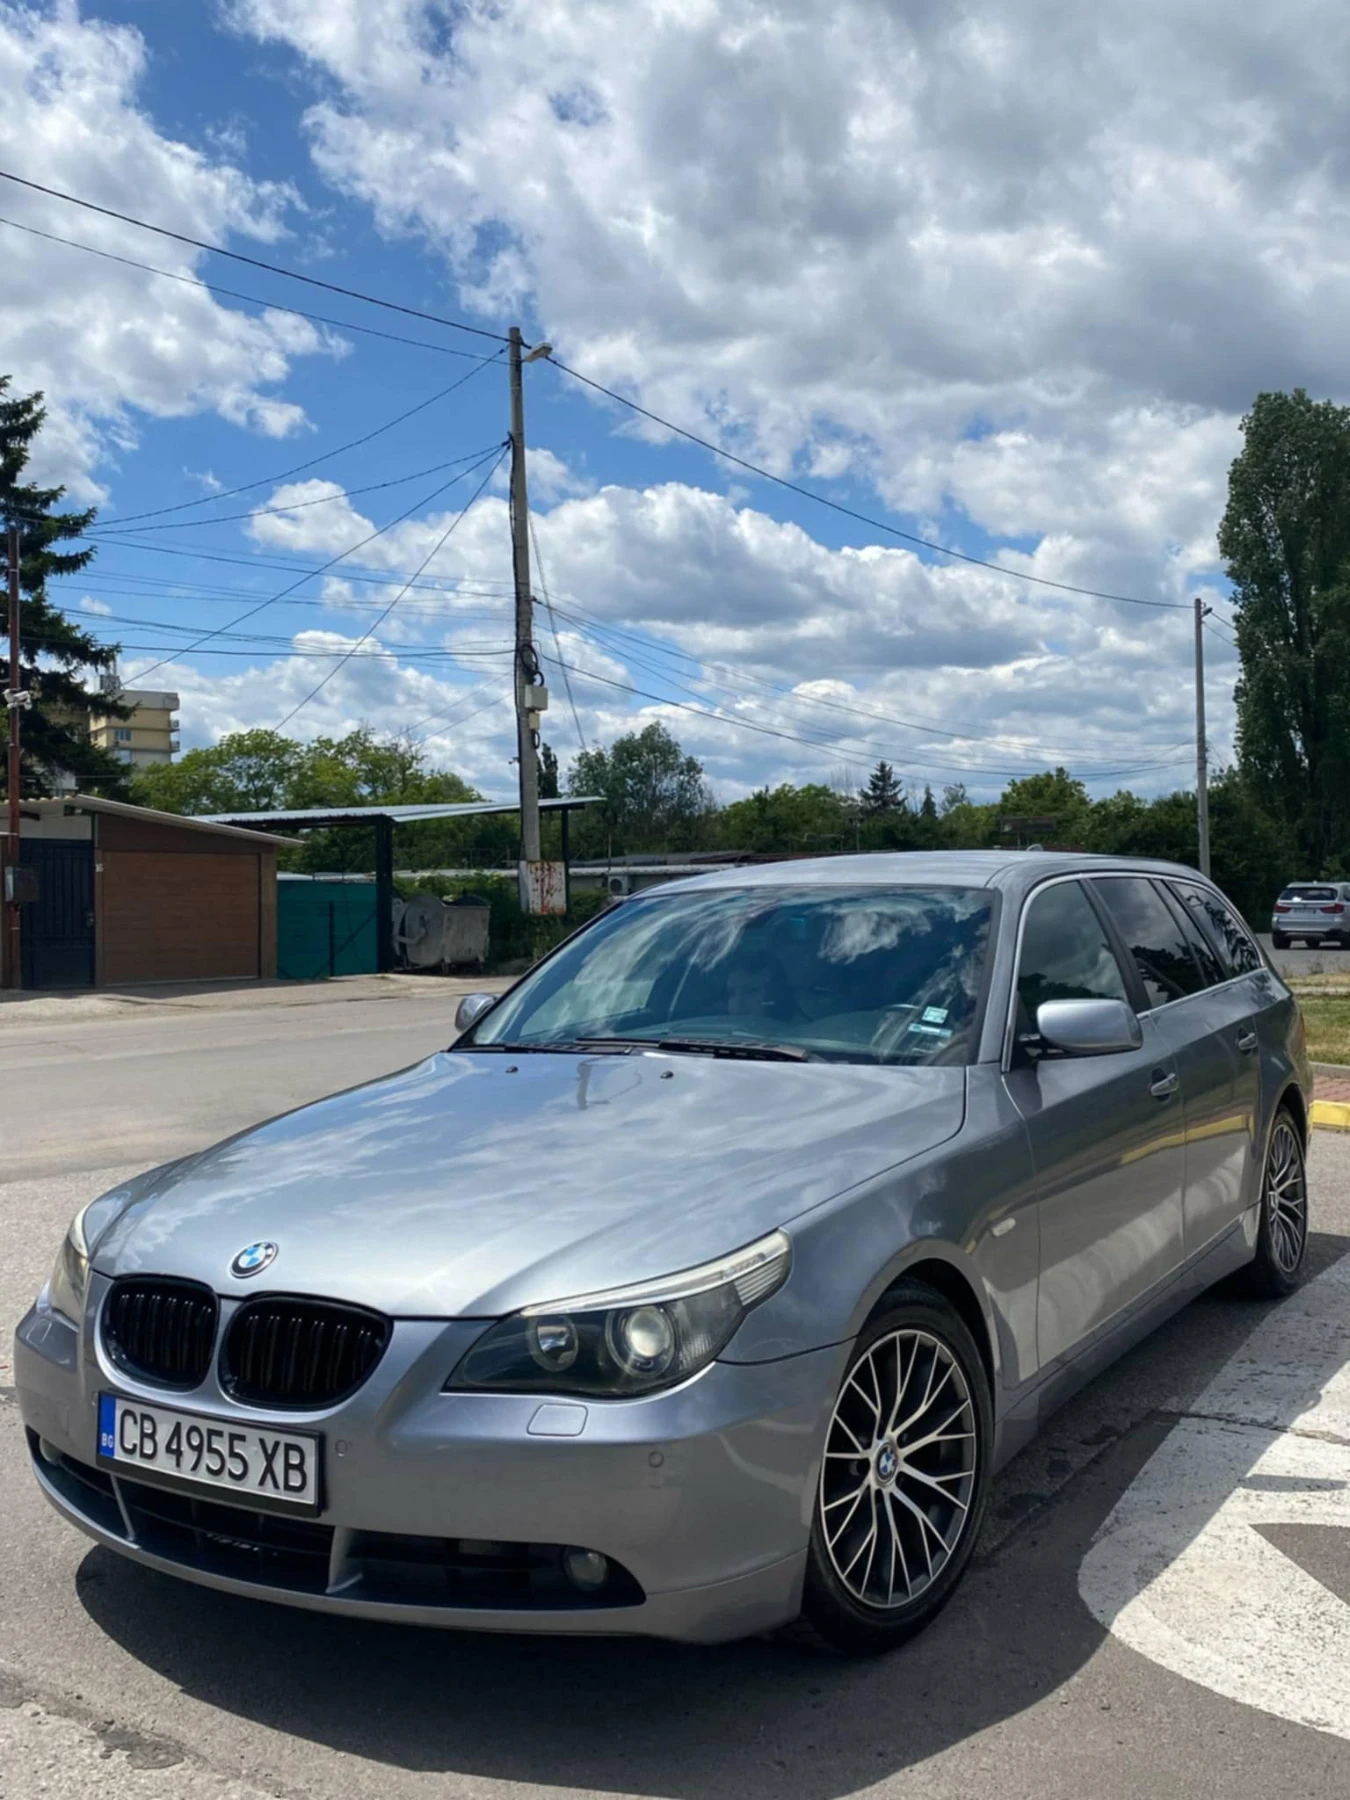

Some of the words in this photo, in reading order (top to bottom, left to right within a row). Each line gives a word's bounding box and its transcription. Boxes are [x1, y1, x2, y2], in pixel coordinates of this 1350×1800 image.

[101, 1432, 114, 1448] BG
[119, 1409, 158, 1460] CB
[165, 1421, 249, 1482] 4955
[258, 1438, 307, 1493] XB
